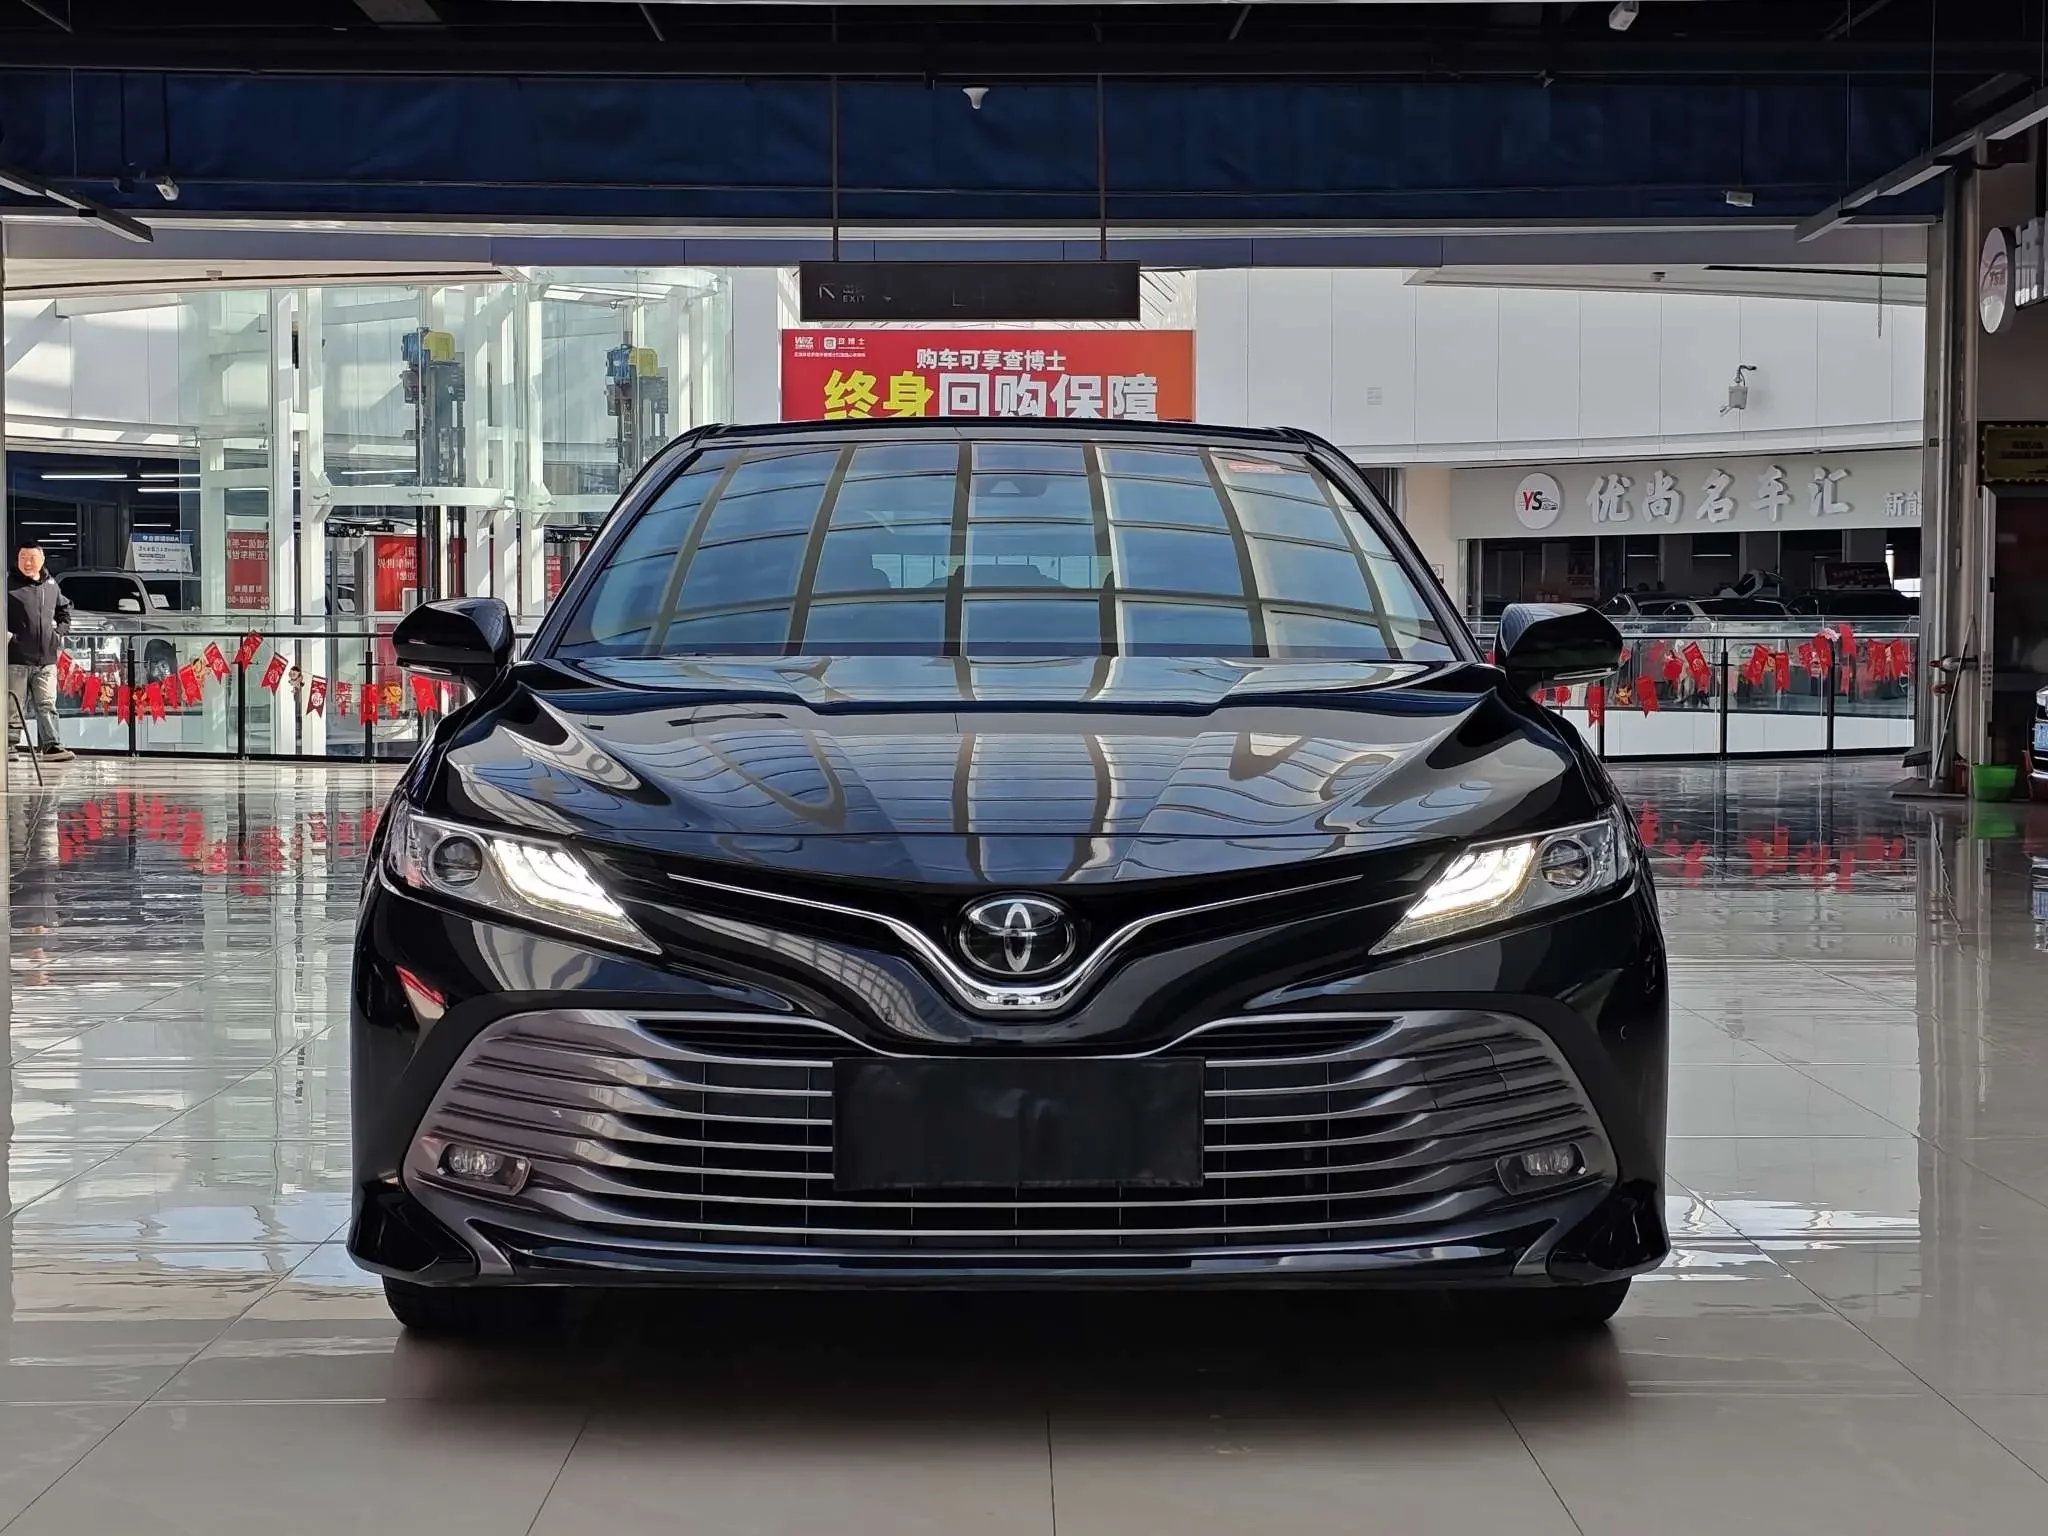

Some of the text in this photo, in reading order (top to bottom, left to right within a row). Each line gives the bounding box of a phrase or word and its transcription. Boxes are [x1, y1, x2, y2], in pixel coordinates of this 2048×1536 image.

[843, 295, 865, 303] EXIT
[916, 348, 1067, 371] 购车可享查博士
[823, 369, 1158, 421] 终身回购保障
[1522, 490, 1543, 511] YS
[1587, 464, 1851, 523] 优尚名车汇
